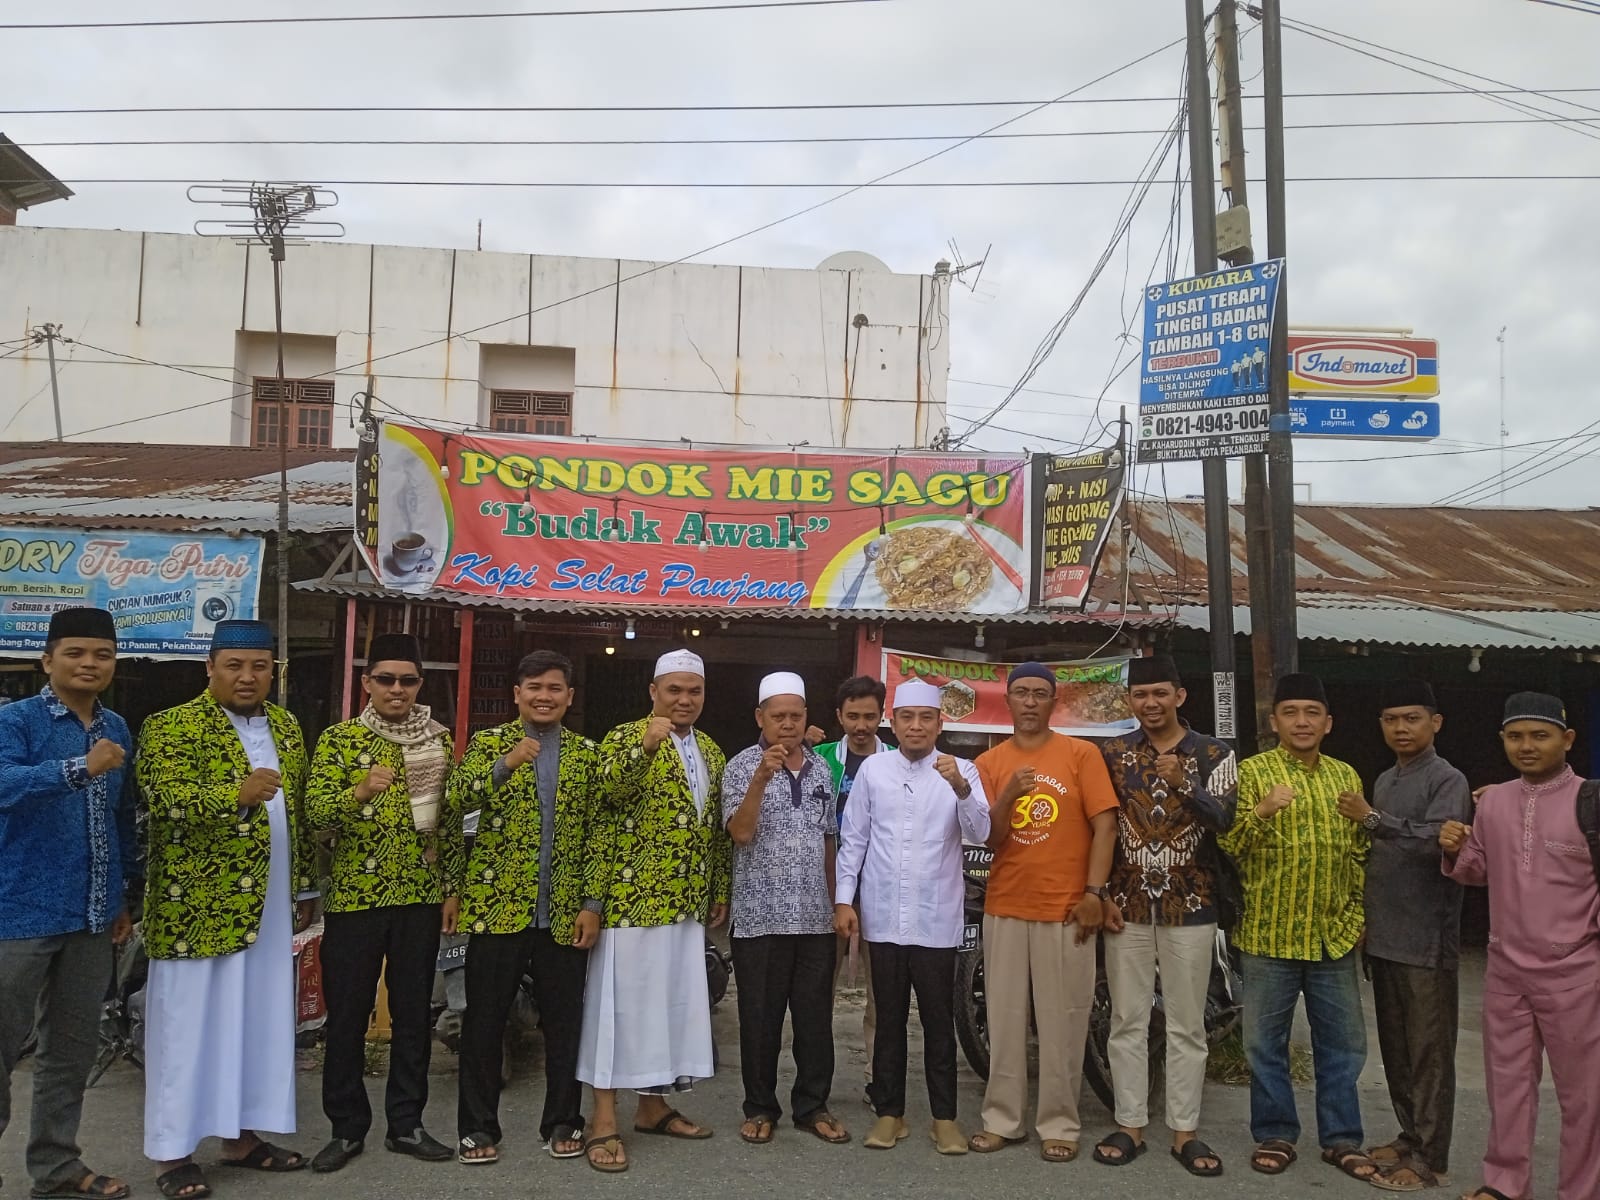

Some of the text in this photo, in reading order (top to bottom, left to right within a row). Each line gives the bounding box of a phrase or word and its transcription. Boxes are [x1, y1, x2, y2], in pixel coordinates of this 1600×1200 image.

[1168, 269, 1254, 297] KUMARA
[1156, 285, 1267, 320] PUSAT TERAPI
[1154, 304, 1267, 337] TINGGI BADAN
[1149, 331, 1214, 356] TAMBAH
[1217, 326, 1243, 346] 1-8
[1150, 350, 1219, 371] TERBUKTI
[1302, 352, 1407, 375] Indomaret
[1142, 367, 1229, 385] HASILNYA LANGSUNG
[1158, 379, 1212, 392] BISA DILIHAT
[1140, 400, 1202, 415] MENYEMBUHKAN
[1203, 397, 1222, 408] KAKI
[1223, 395, 1246, 407] LETER
[1247, 394, 1254, 403] O
[1164, 388, 1205, 401] DITEMPAT
[1321, 420, 1355, 428] payment
[1152, 437, 1196, 450] KAHARUDDIN
[1196, 437, 1210, 447] NST
[1230, 433, 1259, 445] TENGKU
[1156, 448, 1178, 460] BUKIT
[1200, 446, 1219, 457] KOTA
[1220, 443, 1264, 456] PEKANBARU
[460, 450, 1011, 508] PONDOK MIE SAGU
[1079, 478, 1108, 499] NASI
[1046, 505, 1064, 525] NASI
[0, 538, 250, 587] DRY Tiga Putri
[451, 552, 809, 606] Kopi Selat Panjang
[60, 585, 84, 596] Rapi
[108, 597, 141, 612] CUCIAN
[143, 590, 183, 606] NUMPUK
[11, 601, 42, 612] Satuan
[133, 608, 185, 626] SOLUSINYA
[24, 638, 46, 649] Raya
[162, 641, 211, 652] Pekanbaru
[900, 656, 1000, 682] PONDOK
[1055, 663, 1122, 683] SAGU
